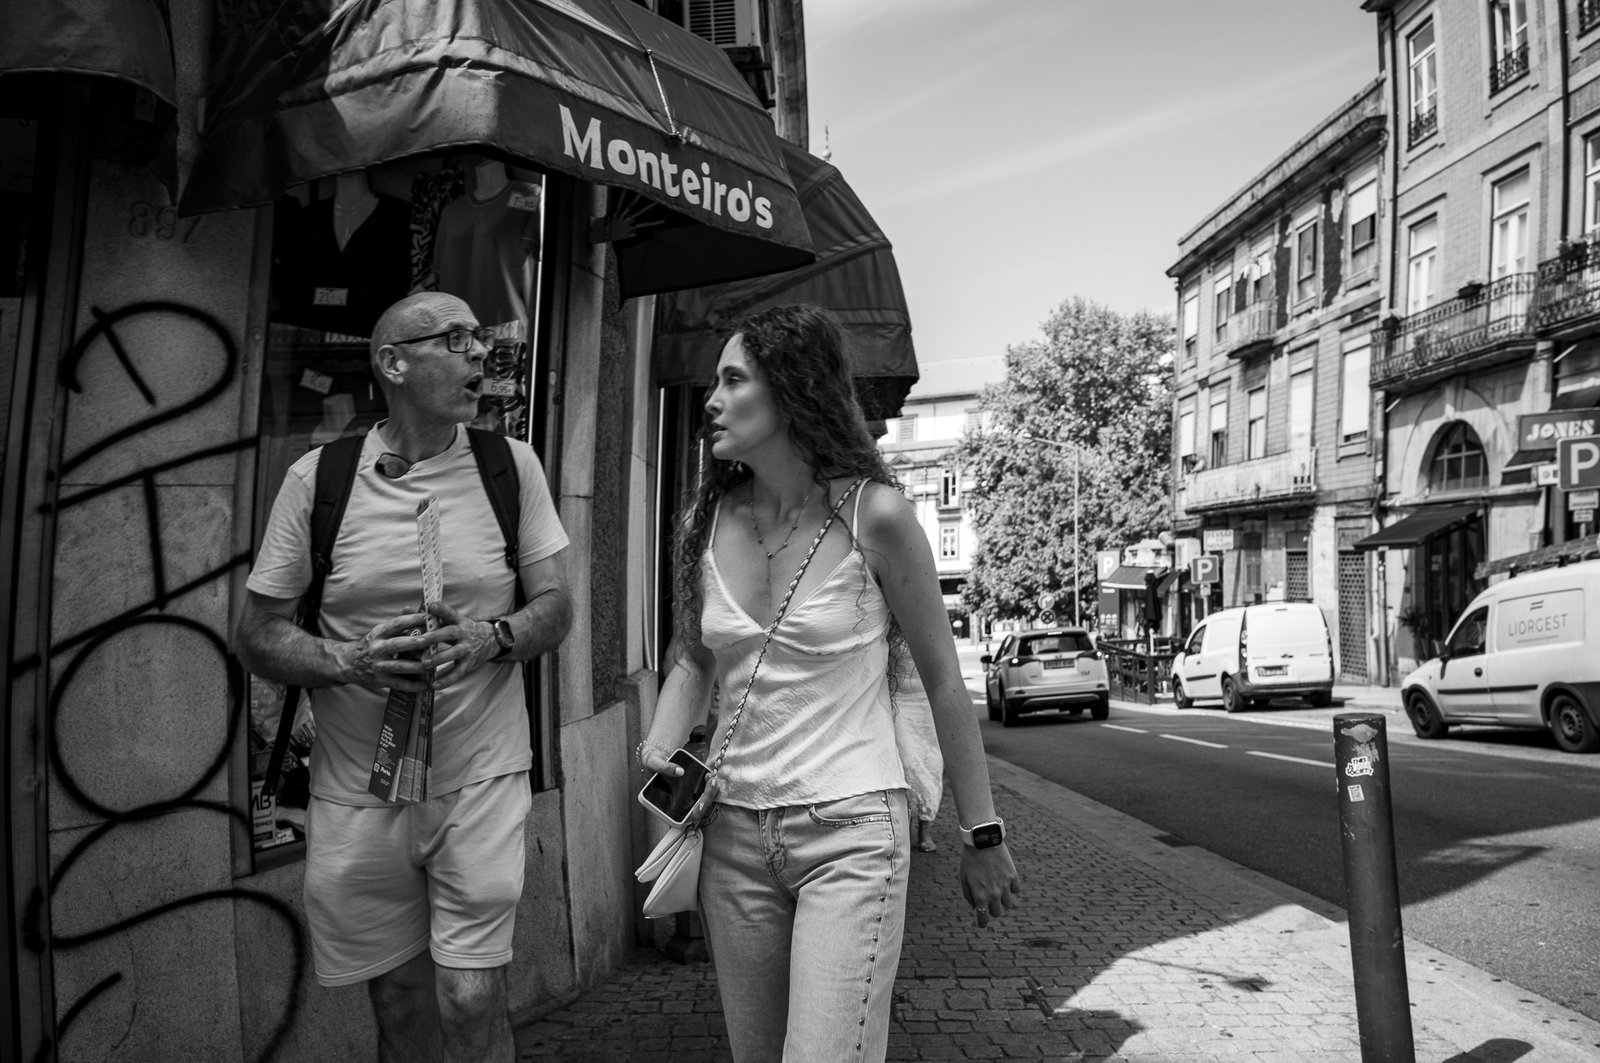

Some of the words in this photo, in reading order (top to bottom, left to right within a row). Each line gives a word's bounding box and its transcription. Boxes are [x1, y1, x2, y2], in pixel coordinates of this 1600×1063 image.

[558, 103, 774, 229] Monteiro's
[1526, 419, 1595, 441] JONES
[1570, 442, 1600, 485] P
[1103, 556, 1114, 574] P
[1197, 559, 1213, 581] P
[1508, 612, 1568, 637] LIORGEST
